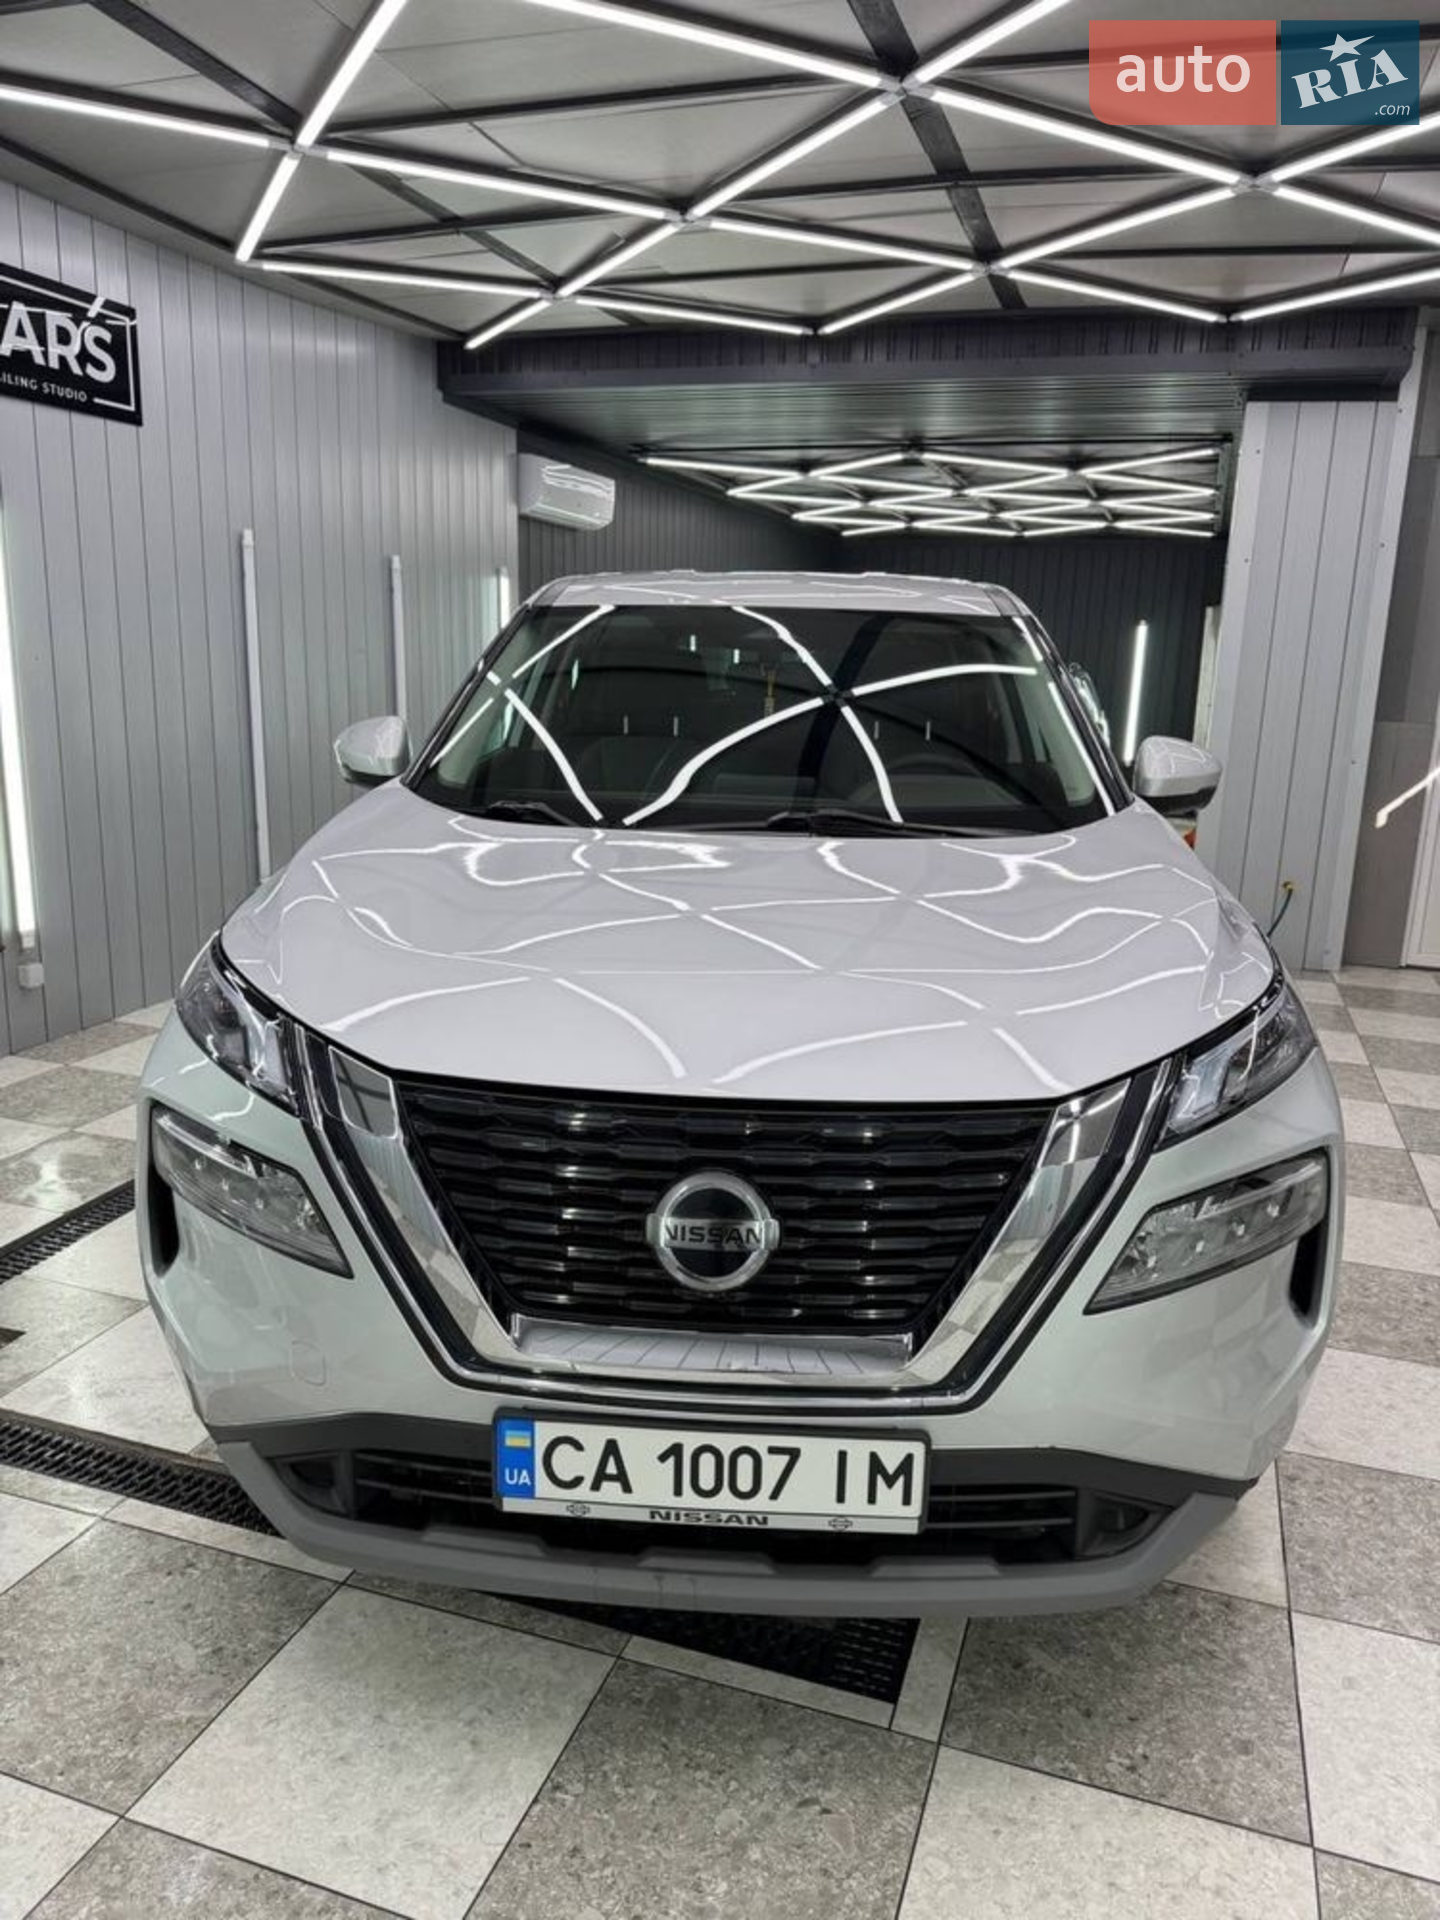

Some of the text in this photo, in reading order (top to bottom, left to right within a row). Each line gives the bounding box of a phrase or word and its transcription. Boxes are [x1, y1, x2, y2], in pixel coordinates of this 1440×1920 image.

[0, 371, 88, 402] ILING STUDIO
[665, 1224, 761, 1245] NISSAN
[504, 1435, 914, 1506] UA CA 1007 IM
[649, 1510, 769, 1526] NISSAN
